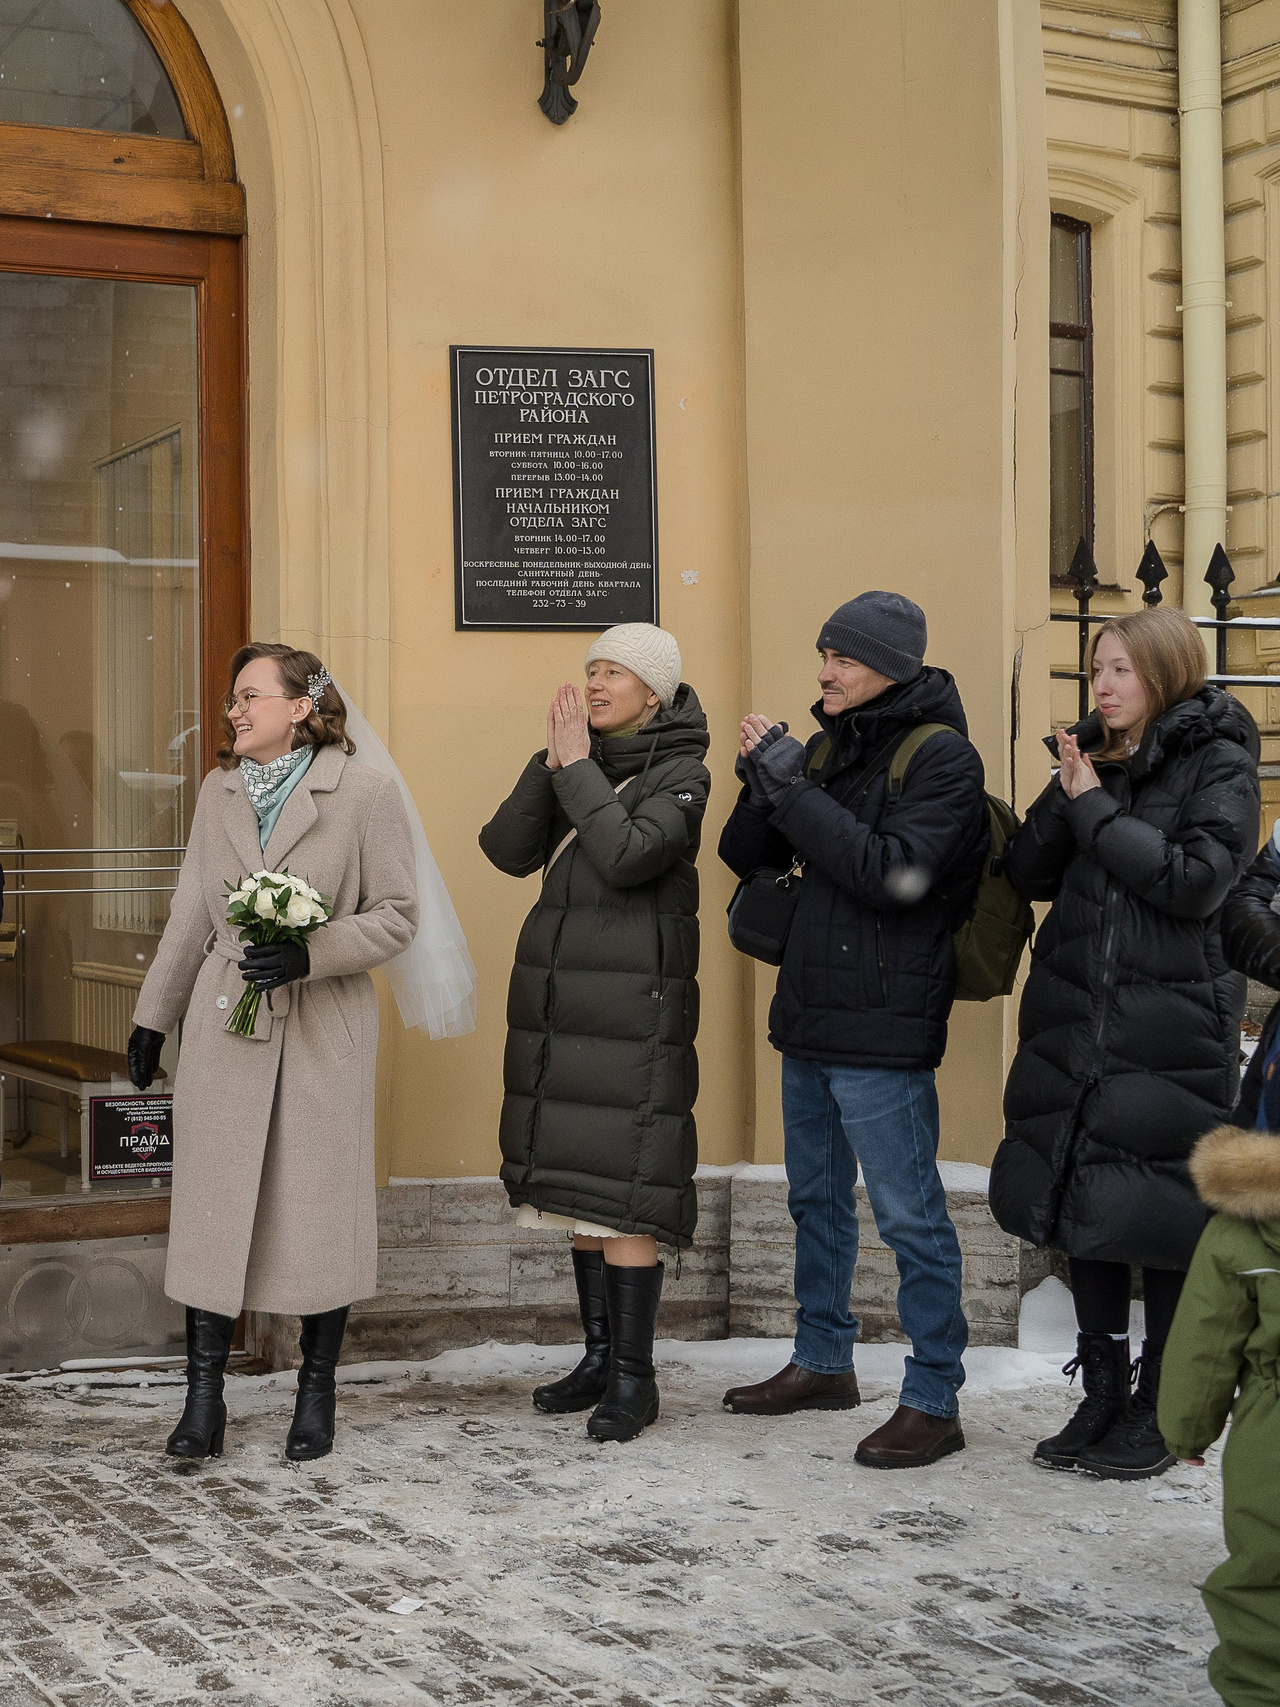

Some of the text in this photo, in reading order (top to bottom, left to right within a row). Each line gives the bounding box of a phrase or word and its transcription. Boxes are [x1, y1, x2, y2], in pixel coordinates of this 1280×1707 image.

[476, 368, 631, 390] ОТДЕЛ ЗАГС
[474, 390, 635, 408] ПЕТРОГРАДСКОГО
[520, 407, 590, 424] РАЙОНА
[494, 432, 617, 446] ПРИЕМ ГРАЖДАН
[489, 450, 623, 458] ВТОРНИК-ПЯТНИЦА 10.00-17.00
[511, 461, 604, 470] СУББОТА 10.00-16.00
[511, 473, 604, 482] ПЕРЕРЫВ 13.00-14.00
[495, 488, 620, 500] ПРИЕМ ГРАЖДАН
[506, 503, 610, 514] НАЧАЛЬНИКОМ
[510, 517, 607, 529] ОТДЕЛА ЗАГС
[554, 546, 606, 555] 10.00-13.00
[629, 562, 652, 570] ДЕНЬ
[518, 570, 574, 578] САНИТАРНЫЙ
[476, 579, 641, 589] ПОСЛЕДНИЙ РАБОЧИЙ ДЕНЬ КВАРТАЛА
[549, 590, 582, 598] ОТДЕЛА
[532, 600, 586, 608] 232-73-39
[120, 1133, 170, 1147] ПРАЙД
